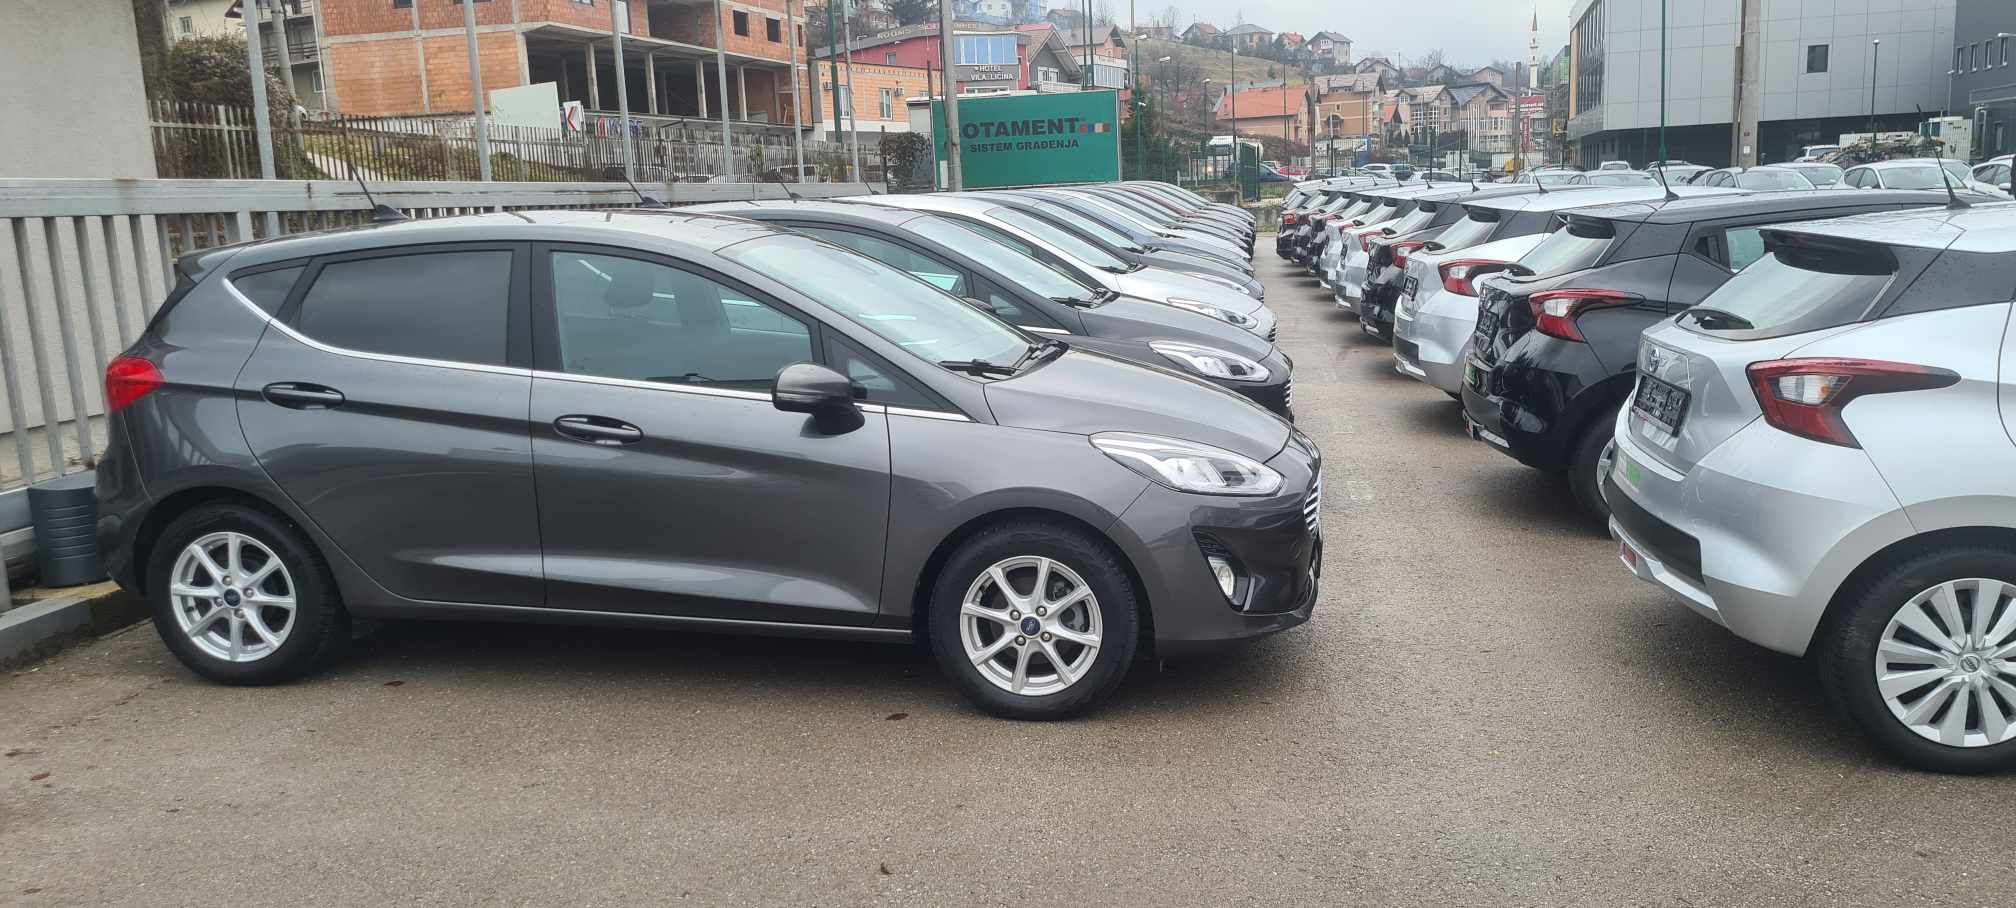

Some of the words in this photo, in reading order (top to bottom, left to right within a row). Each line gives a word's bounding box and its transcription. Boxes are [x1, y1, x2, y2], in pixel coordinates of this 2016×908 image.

[970, 73, 987, 81] VILA
[961, 117, 1080, 140] OTAMENT
[970, 141, 1013, 153] SISTEM
